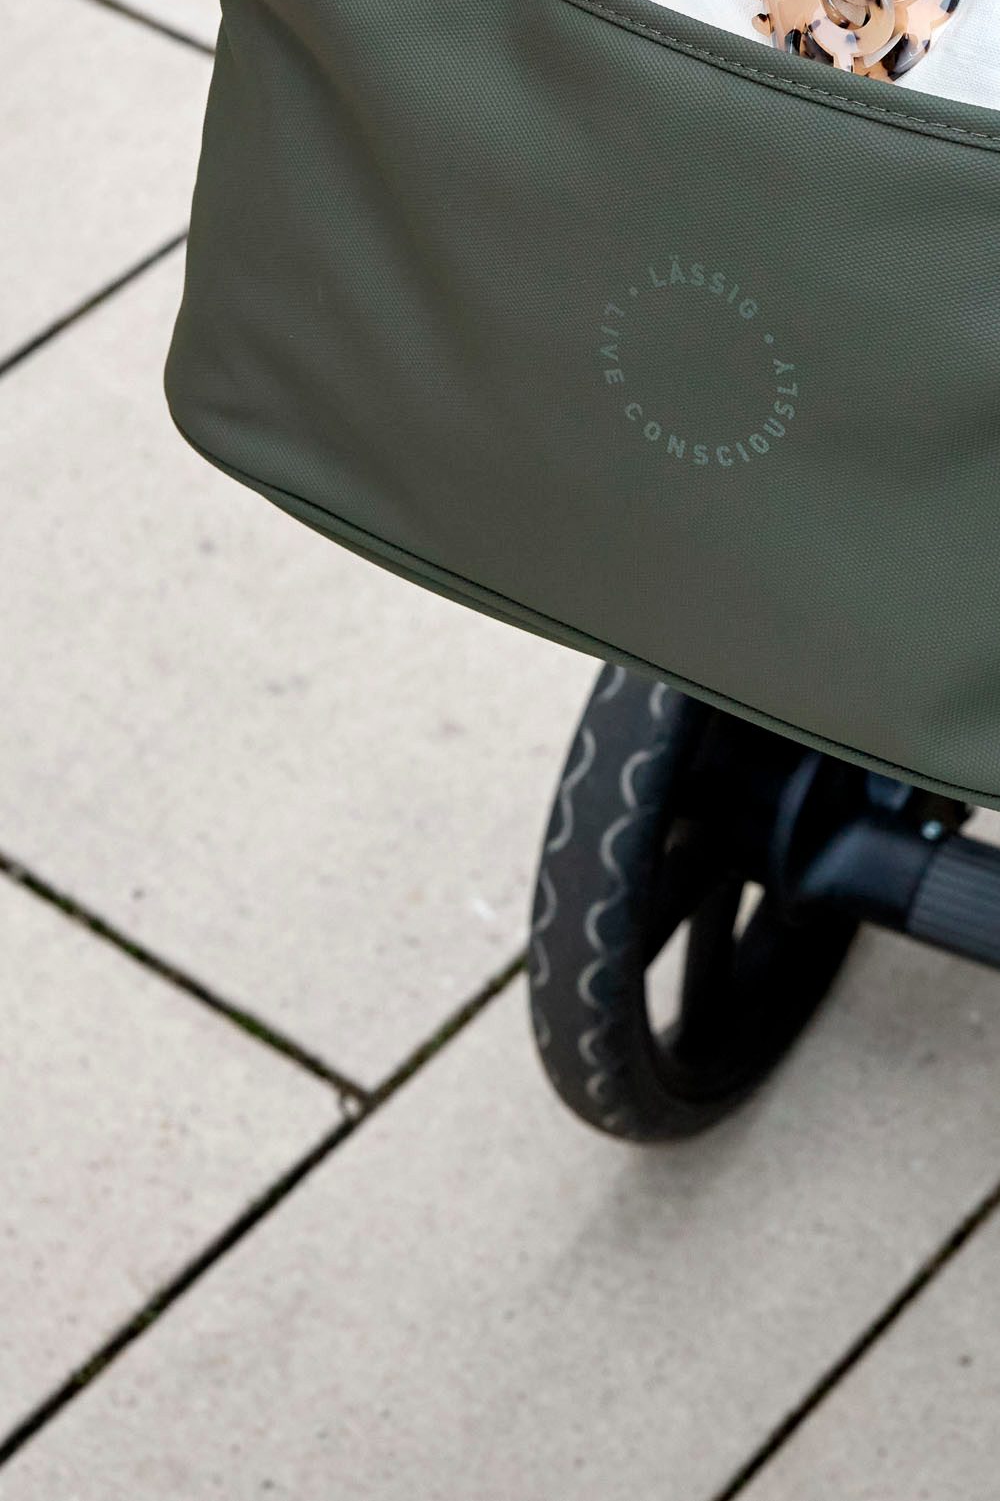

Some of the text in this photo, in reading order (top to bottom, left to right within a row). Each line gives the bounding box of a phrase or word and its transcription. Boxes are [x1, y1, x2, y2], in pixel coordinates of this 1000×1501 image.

[650, 255, 757, 319] LÄSSIG
[600, 302, 798, 467] LIVE CONSCIOUSLY
